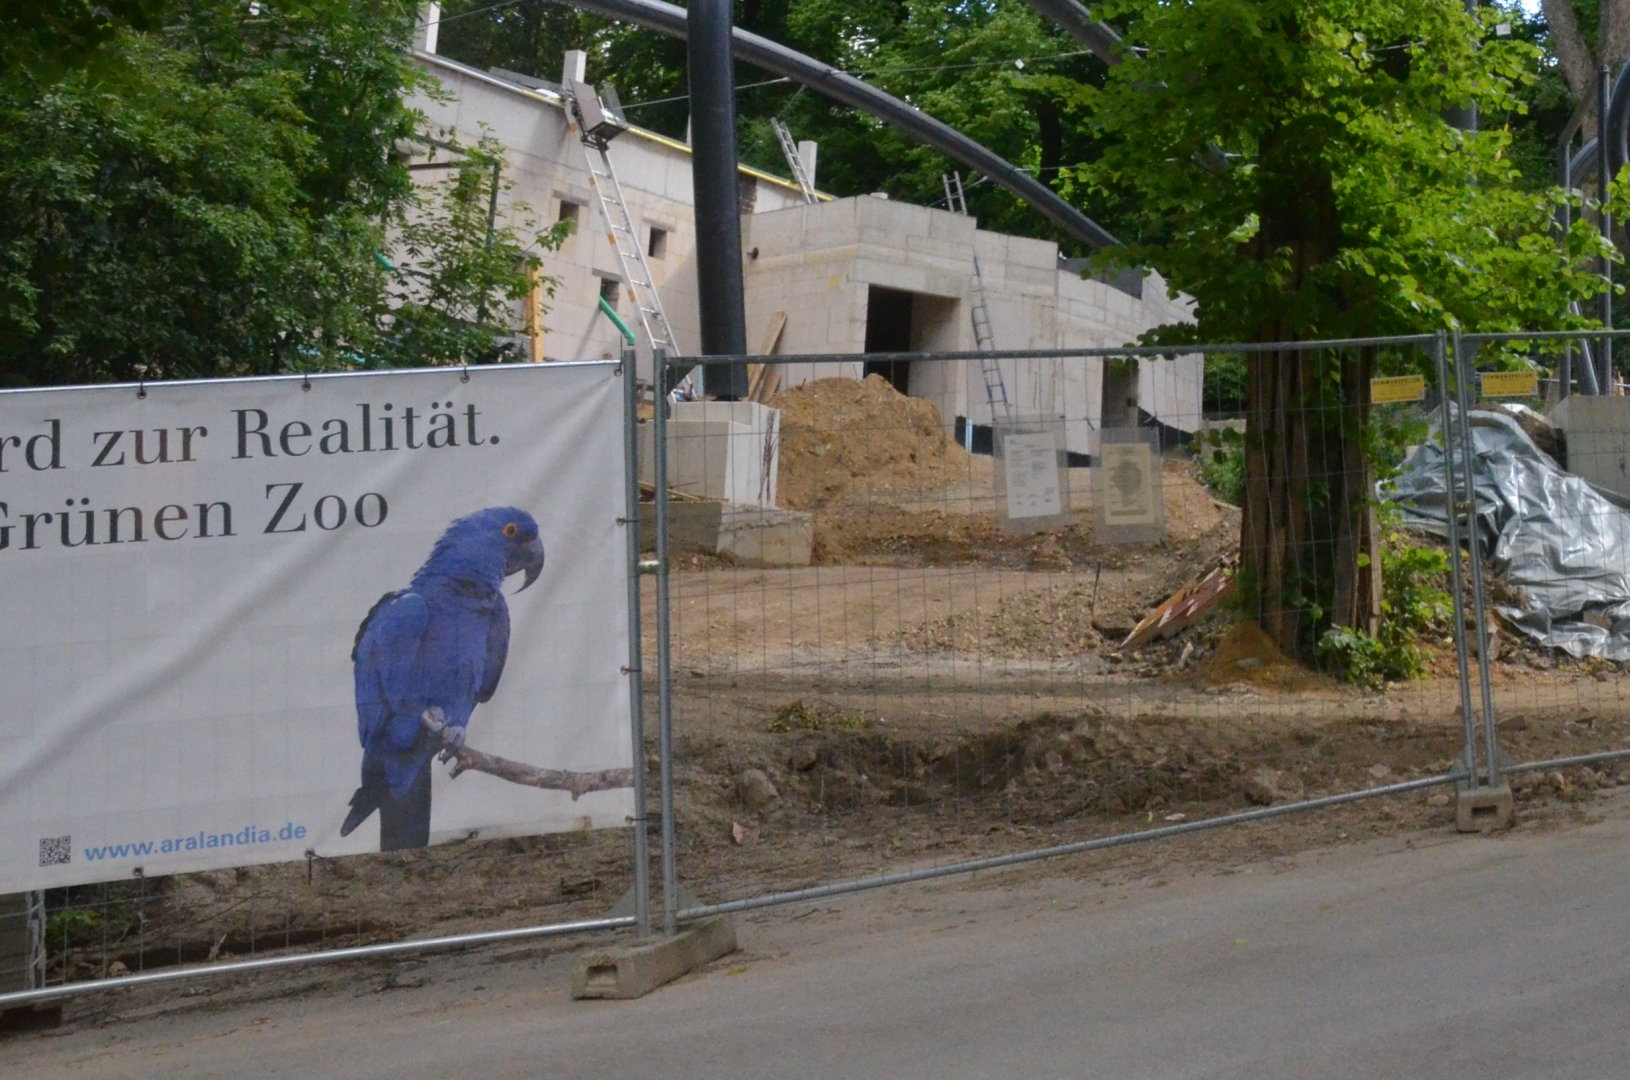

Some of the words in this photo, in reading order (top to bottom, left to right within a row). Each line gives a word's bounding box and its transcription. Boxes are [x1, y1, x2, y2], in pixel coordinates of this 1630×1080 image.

[90, 425, 208, 467] zur
[230, 401, 501, 460] Realität.
[263, 482, 389, 533] Zoo
[84, 822, 307, 861] www.aralandia.de
